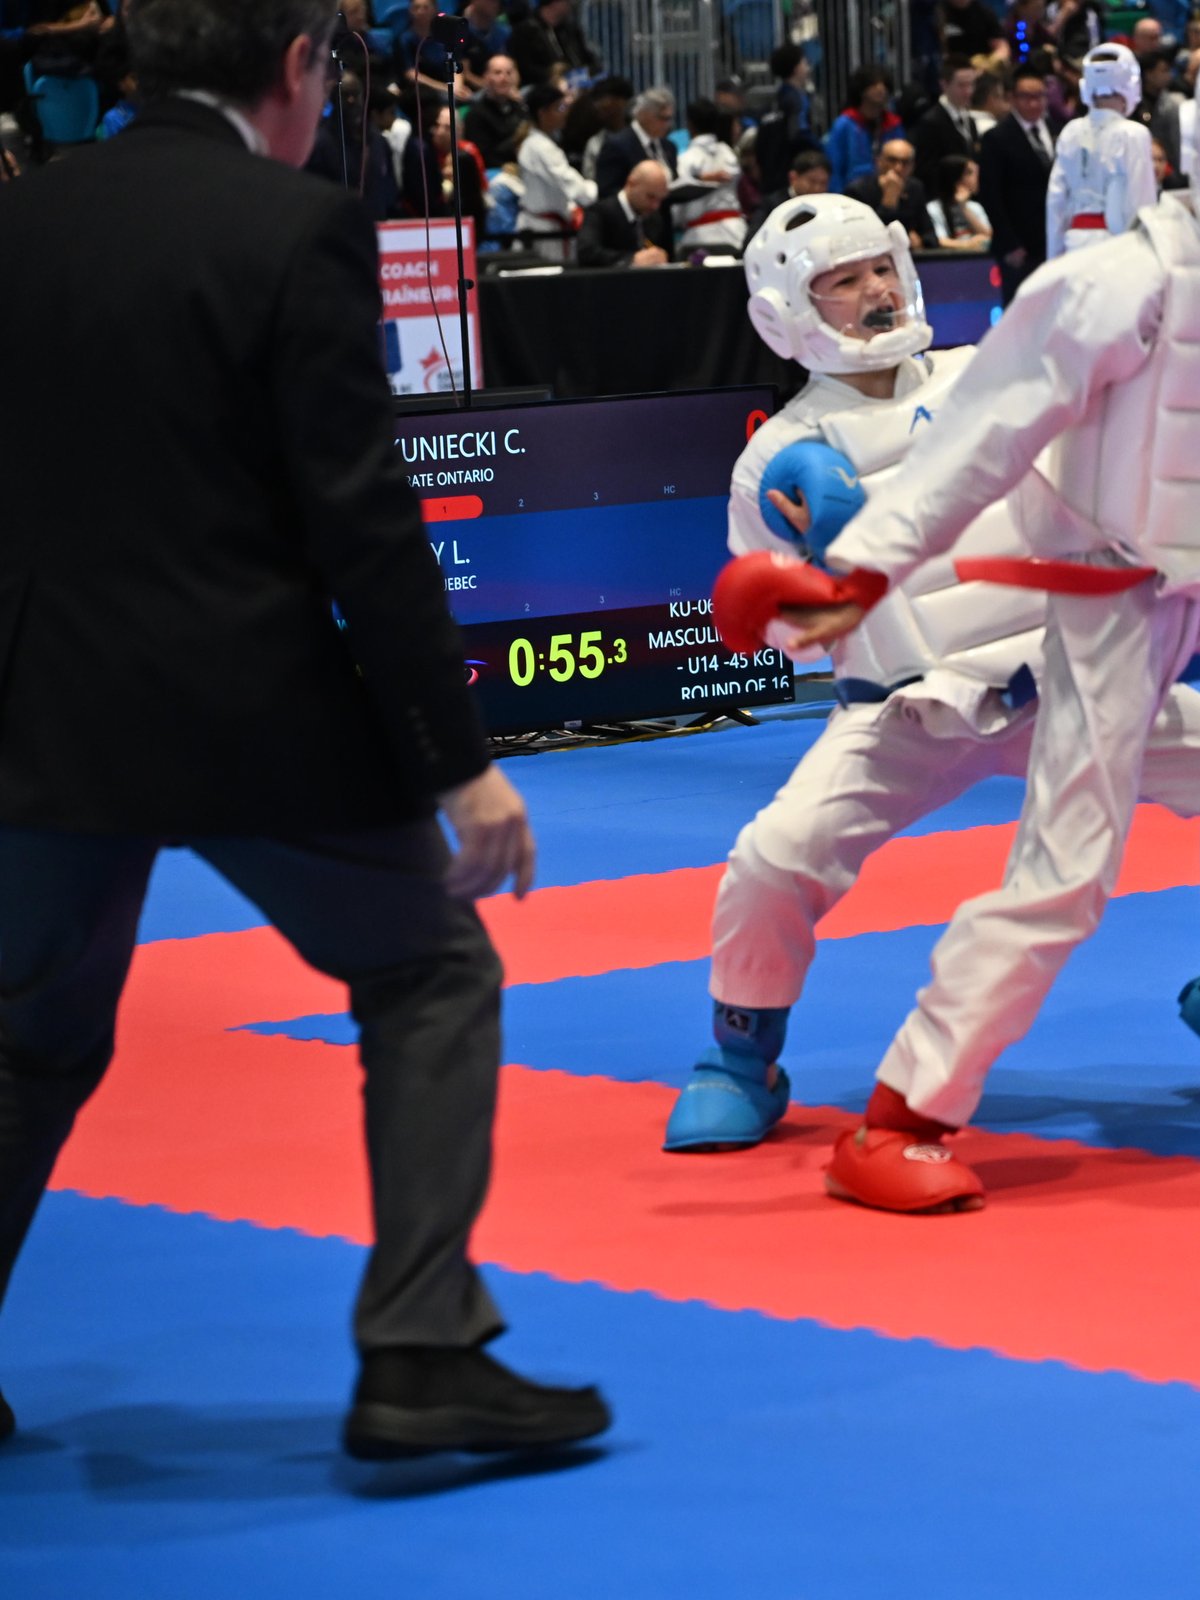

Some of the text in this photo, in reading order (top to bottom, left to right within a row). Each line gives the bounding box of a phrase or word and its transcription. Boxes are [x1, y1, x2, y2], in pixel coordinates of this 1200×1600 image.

[381, 261, 439, 280] COACH
[394, 429, 526, 463] UNIECKI C.
[437, 468, 494, 486] ONTARIO
[593, 491, 600, 501] 3
[664, 485, 676, 494] HC
[518, 498, 525, 508] 2
[453, 540, 470, 564] L.
[670, 588, 682, 597] HC
[524, 603, 531, 612] 2
[648, 625, 723, 649] MASCULI
[509, 630, 627, 687] 0:55.3
[688, 655, 718, 674] U14
[723, 652, 748, 669] -45
[753, 649, 774, 667] KG
